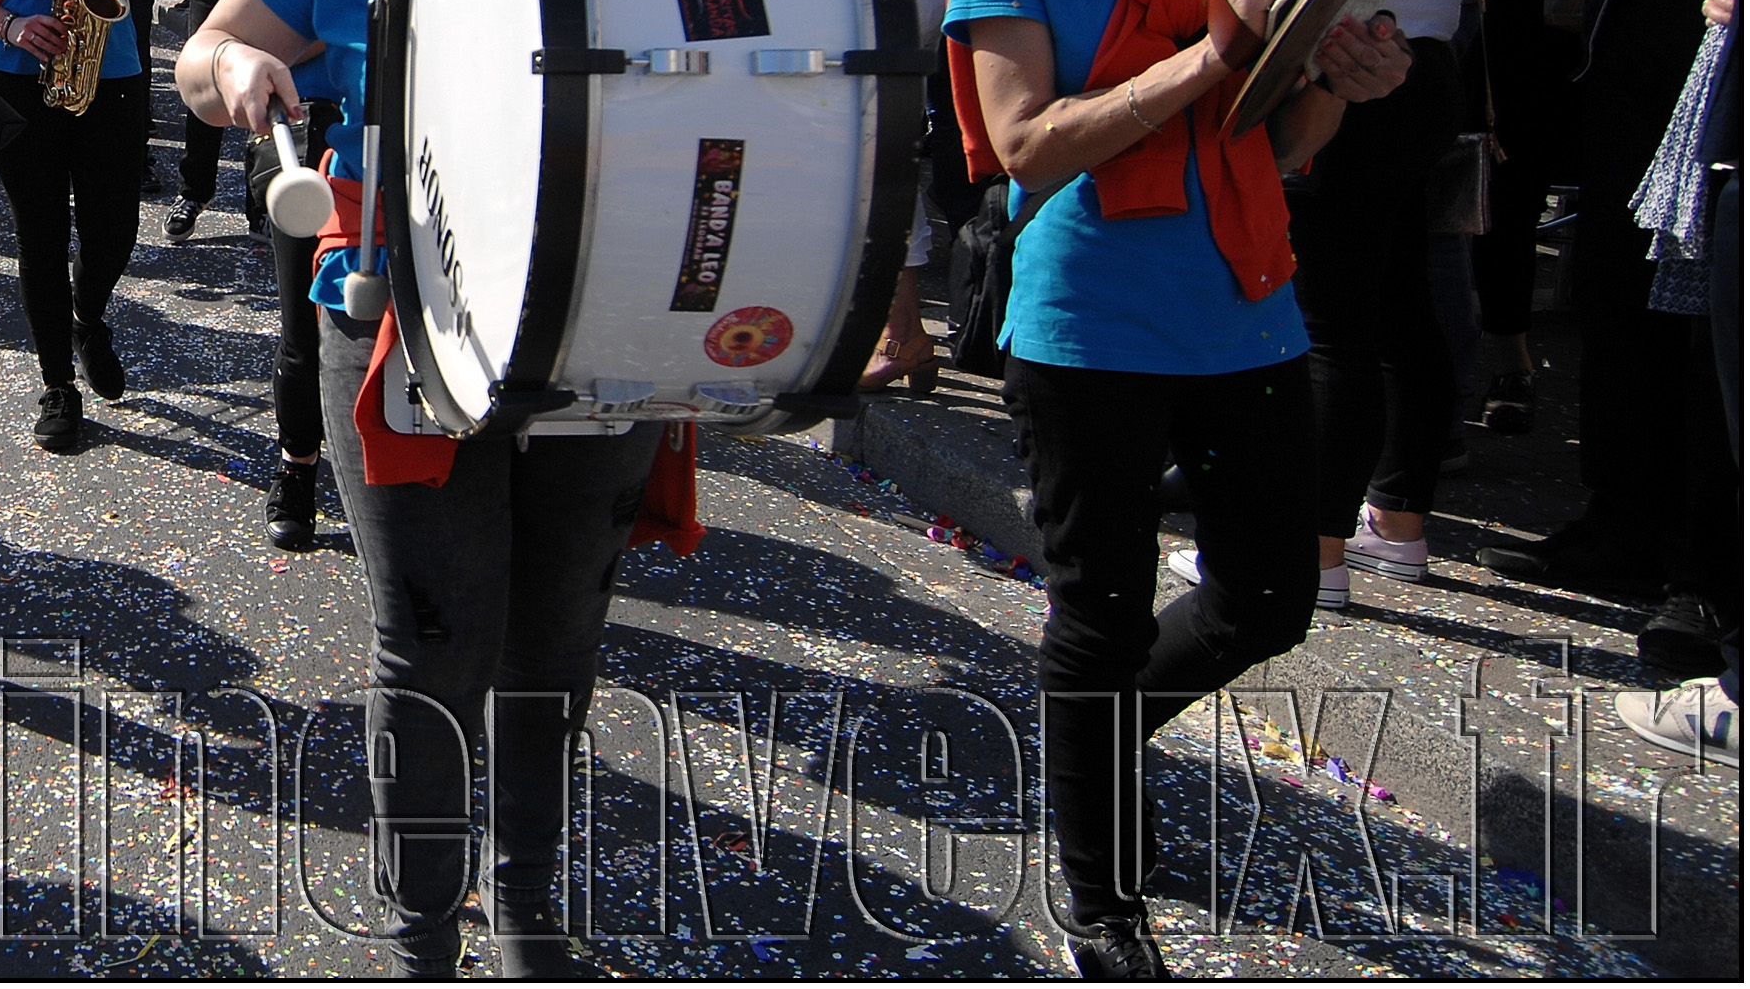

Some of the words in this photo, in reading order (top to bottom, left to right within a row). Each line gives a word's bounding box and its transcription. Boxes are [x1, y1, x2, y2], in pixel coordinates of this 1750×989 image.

[418, 135, 463, 308] SONOR
[705, 179, 734, 248] BAND'A
[697, 252, 722, 284] LEO
